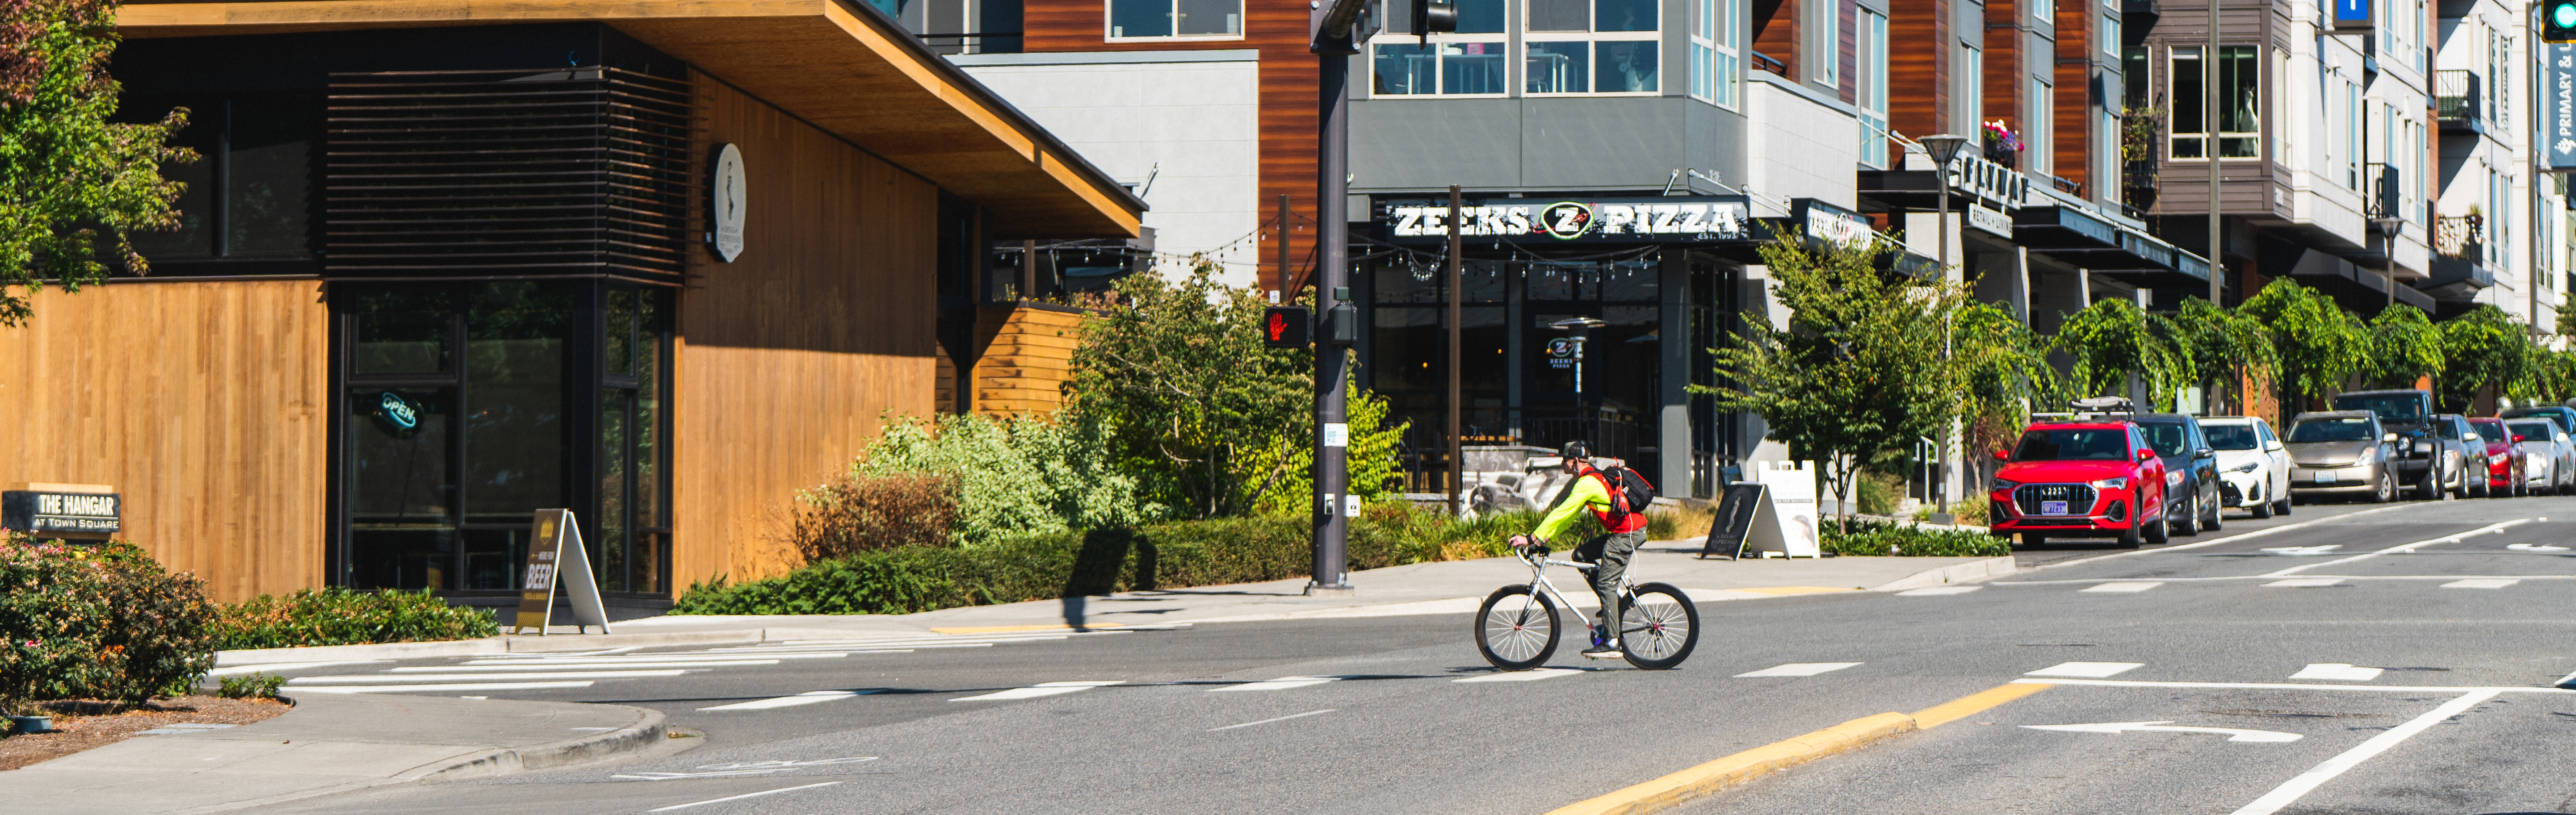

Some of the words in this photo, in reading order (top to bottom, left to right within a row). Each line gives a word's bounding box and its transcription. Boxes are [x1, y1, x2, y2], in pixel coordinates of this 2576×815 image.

[2559, 71, 2572, 137] PRIMARY
[1604, 204, 1739, 234] PIZZA
[1973, 209, 1990, 226] RETAIL
[382, 397, 415, 421] OPEN
[39, 494, 62, 514] THE
[65, 495, 114, 516] HANGAR
[34, 518, 46, 527] AT
[48, 518, 76, 527] TOWN
[80, 519, 119, 529] SQUARE
[525, 563, 553, 589] BEER
